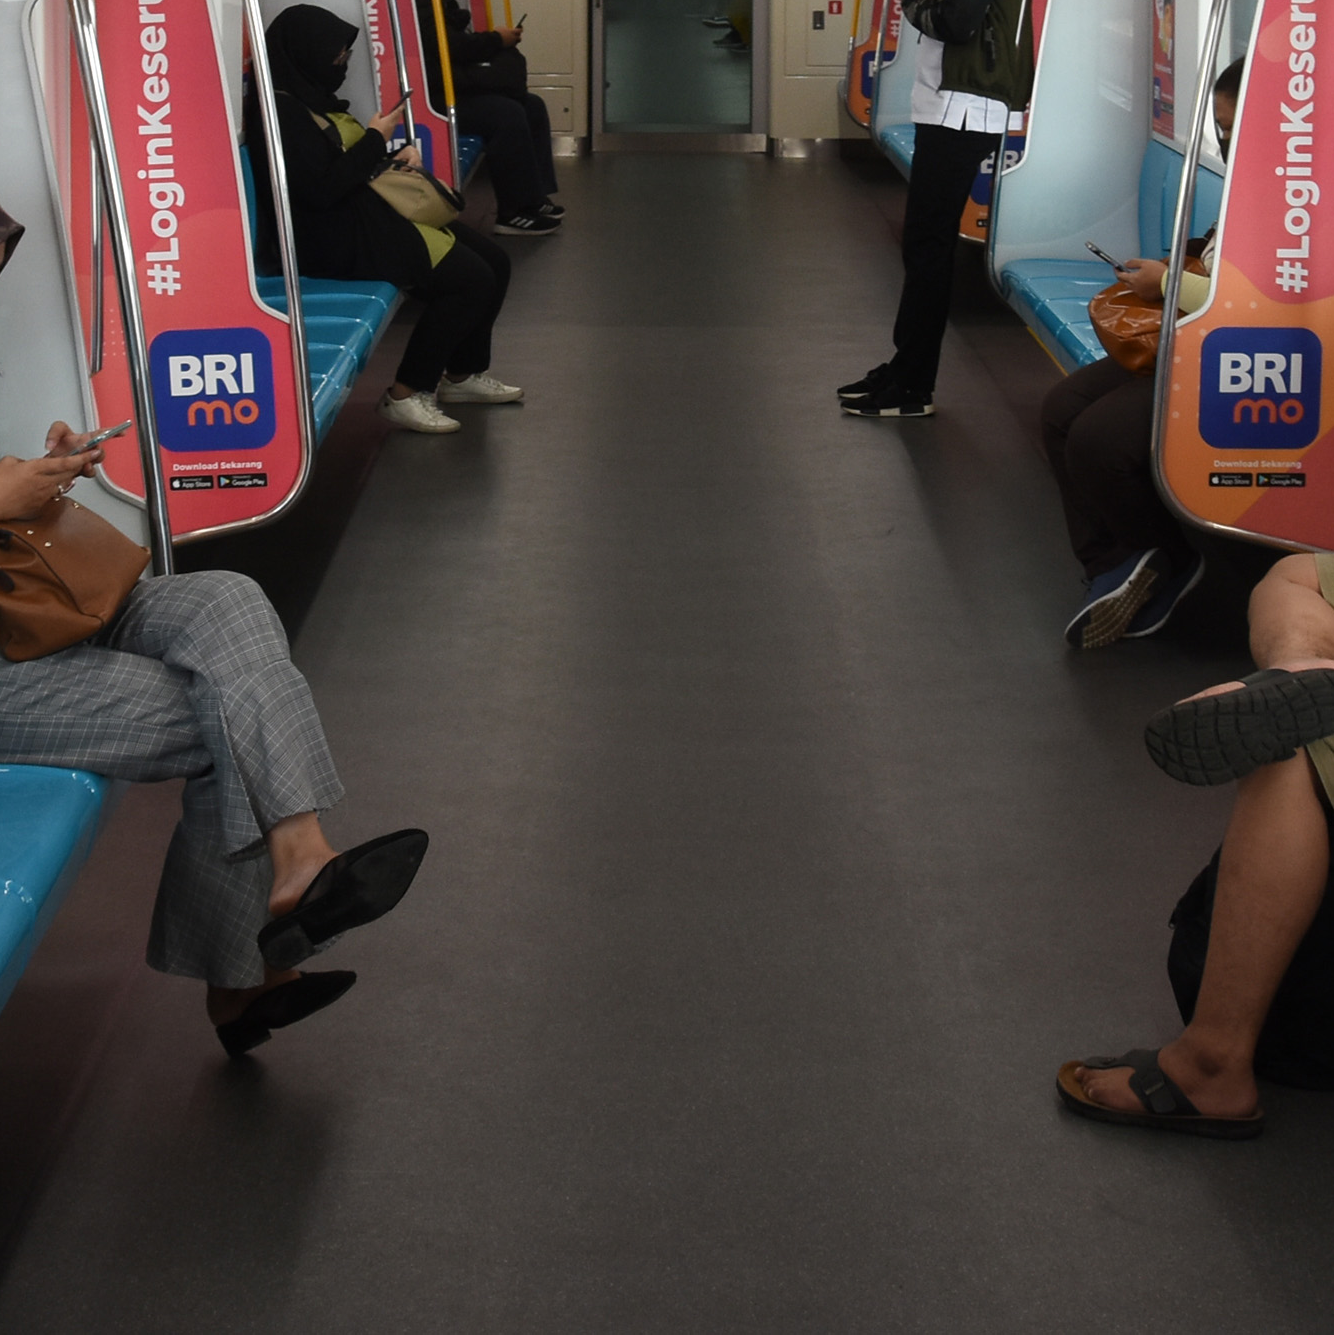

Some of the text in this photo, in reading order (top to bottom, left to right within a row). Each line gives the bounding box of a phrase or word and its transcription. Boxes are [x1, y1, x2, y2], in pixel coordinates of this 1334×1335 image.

[169, 353, 254, 396] BRI
[1219, 353, 1303, 393] BRI
[188, 399, 259, 426] mo
[1233, 399, 1304, 424] mo
[172, 461, 263, 472] Download Sekarang
[1214, 459, 1302, 469] Download Sekarang
[232, 478, 266, 487] Google Play
[1270, 478, 1291, 486] Google
